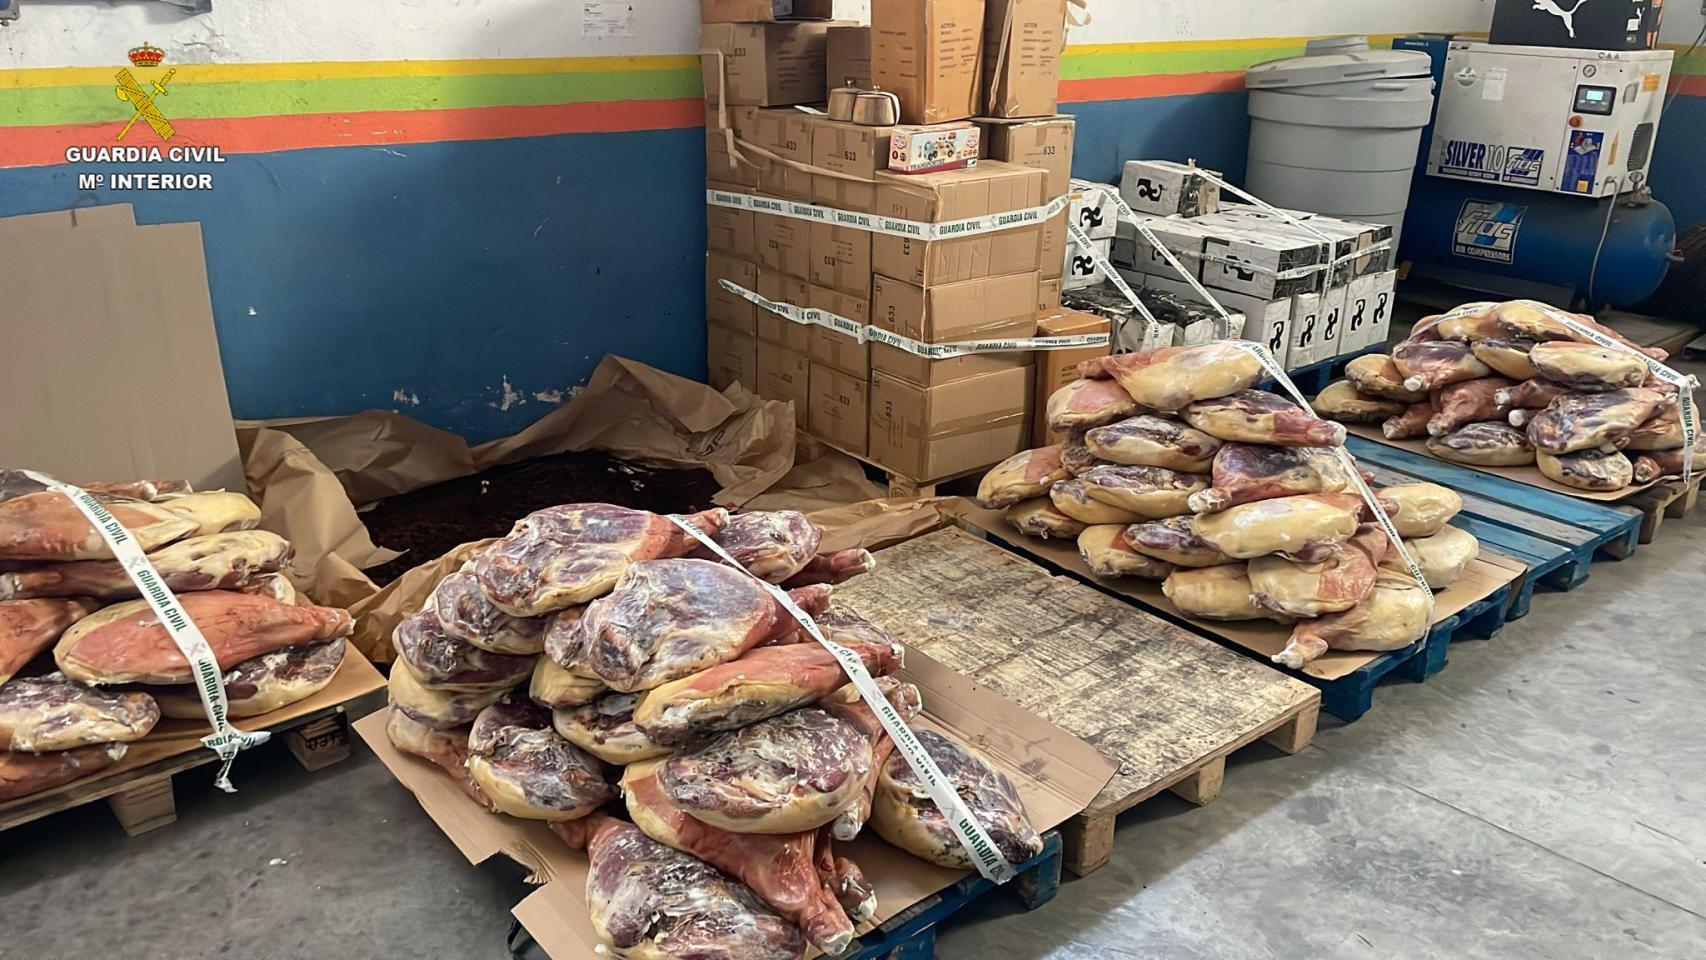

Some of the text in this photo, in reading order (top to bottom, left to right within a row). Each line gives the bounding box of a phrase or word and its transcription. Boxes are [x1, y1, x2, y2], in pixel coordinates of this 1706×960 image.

[1043, 146, 1056, 155] 633
[1445, 140, 1505, 171] SILVER 10
[753, 199, 782, 211] GUARDIA CIVIL
[794, 206, 825, 219] GUARDIA CIVIL
[837, 212, 871, 227] GUARDIA CIVIL
[998, 211, 1038, 225] GUARDIA CIVIL
[885, 220, 920, 235] GUARDIA CIVIL
[939, 220, 982, 235] GUARDIA CIVIL
[1455, 245, 1511, 261] AIR COMPRESSORS
[807, 311, 821, 321] CIVIL
[888, 304, 896, 323] 633
[975, 342, 1003, 350] GUARDIA
[1681, 397, 1694, 447] GUARDIA CIVIL
[80, 494, 129, 545] GUARDIA CIVIL
[137, 569, 188, 633] GUARDIA CIVIL
[198, 657, 219, 703] GUARDIA
[958, 818, 995, 867] GUARDIA
